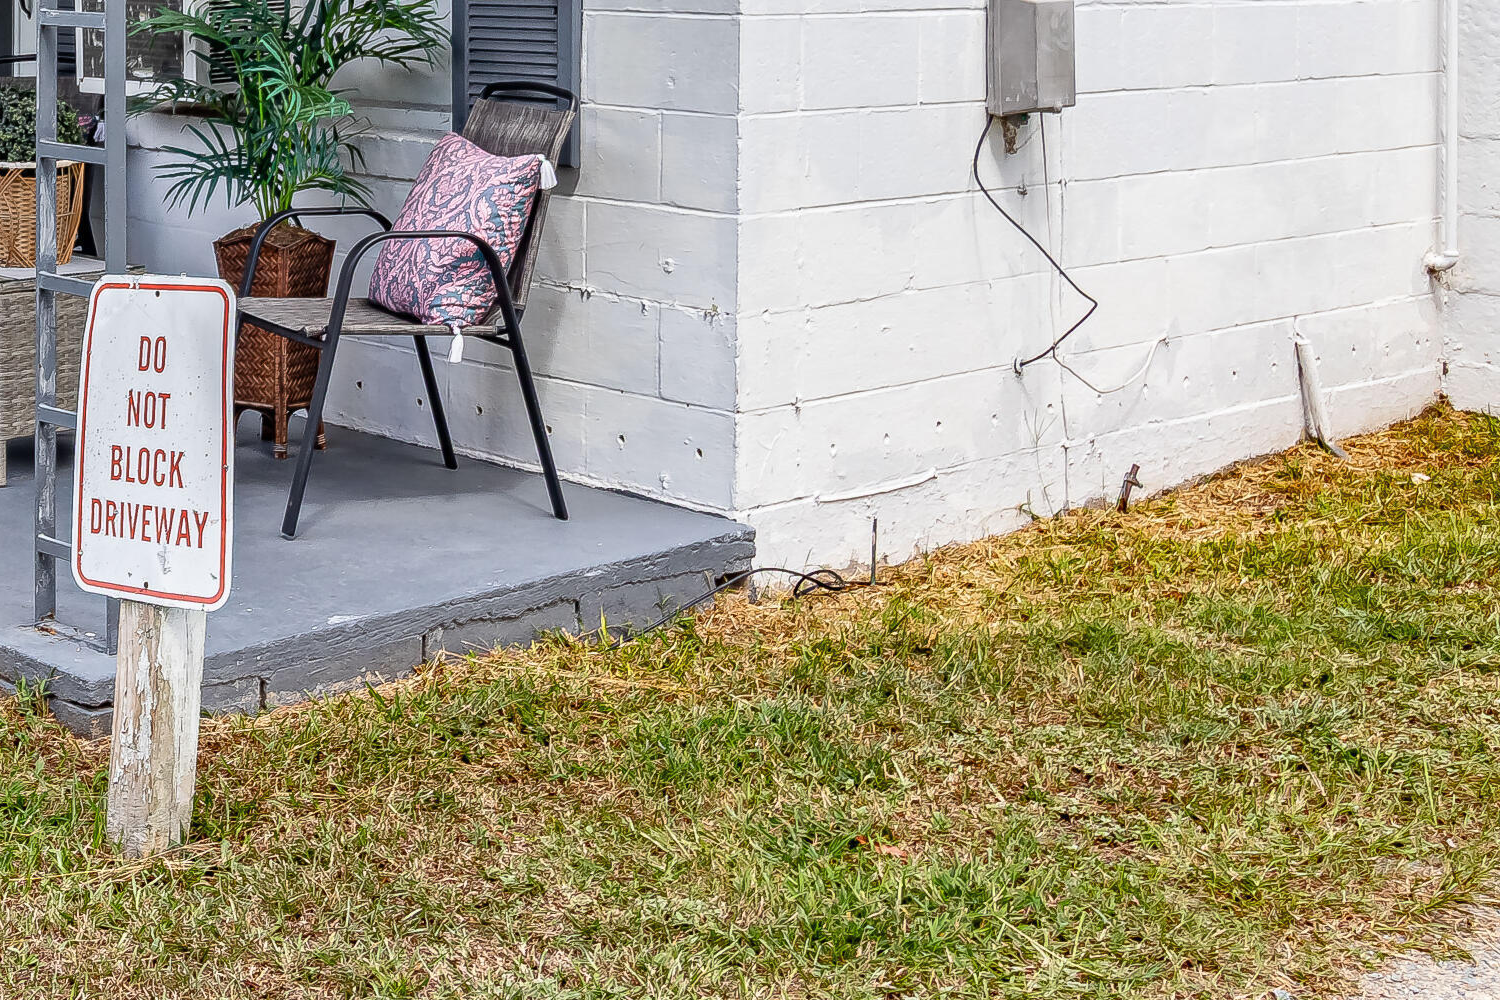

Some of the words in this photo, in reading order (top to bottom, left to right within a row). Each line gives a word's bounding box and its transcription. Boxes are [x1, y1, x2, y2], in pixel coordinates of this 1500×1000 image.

[138, 336, 167, 373] DO
[127, 389, 171, 429] NOT
[110, 445, 184, 488] BLOCK
[90, 498, 209, 548] DRIVEWAY
